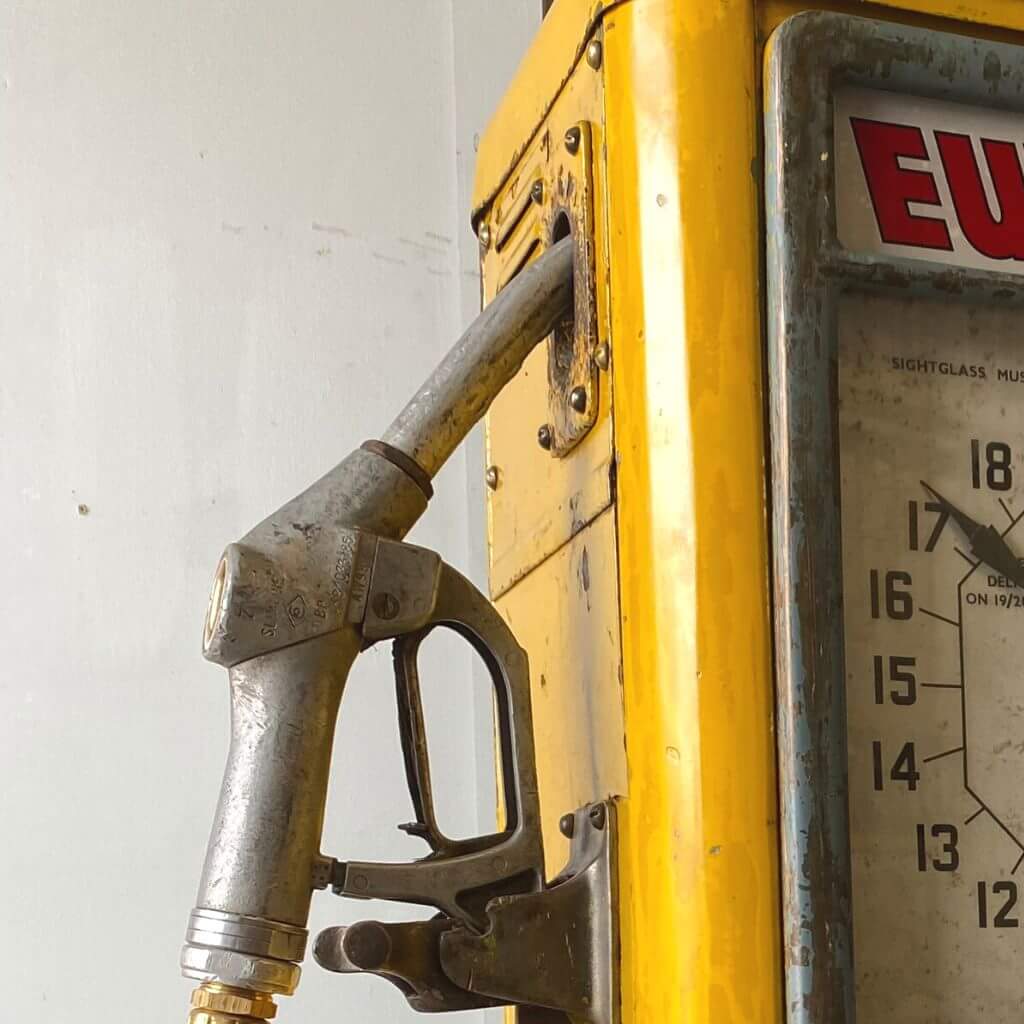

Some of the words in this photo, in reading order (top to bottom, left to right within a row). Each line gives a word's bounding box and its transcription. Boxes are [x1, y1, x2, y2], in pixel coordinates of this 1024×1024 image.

[891, 357, 986, 378] SIGHTGLASS
[971, 439, 1012, 491] 18
[908, 501, 951, 552] 17
[870, 569, 913, 620] 16
[966, 592, 987, 605] ON
[873, 655, 917, 705] 15
[872, 741, 920, 791] 14
[916, 823, 959, 872] 13
[977, 880, 1019, 928] 12
